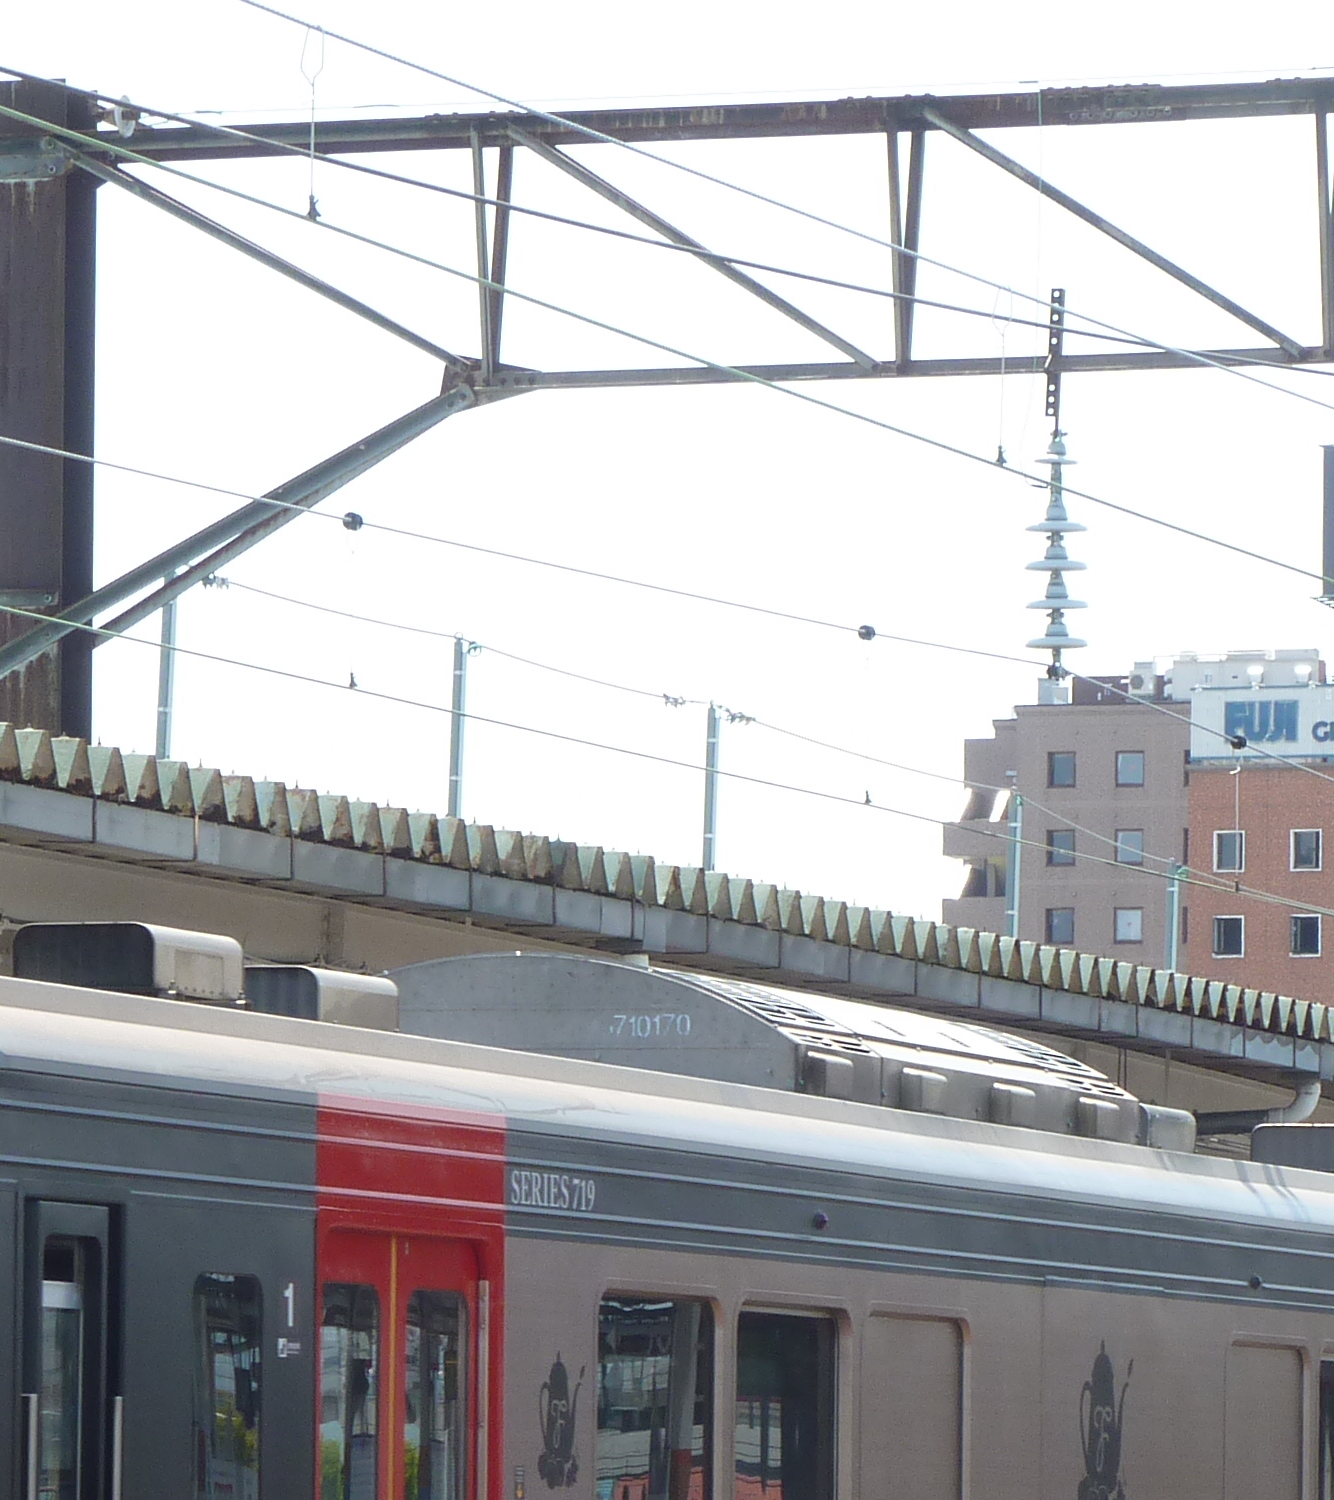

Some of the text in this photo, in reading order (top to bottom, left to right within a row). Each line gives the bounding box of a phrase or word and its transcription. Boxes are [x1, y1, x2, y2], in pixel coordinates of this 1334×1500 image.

[1224, 700, 1299, 742] FUJI
[613, 1013, 691, 1038] 710170
[510, 1170, 596, 1211] SERIES 719
[283, 1282, 295, 1328] 1
